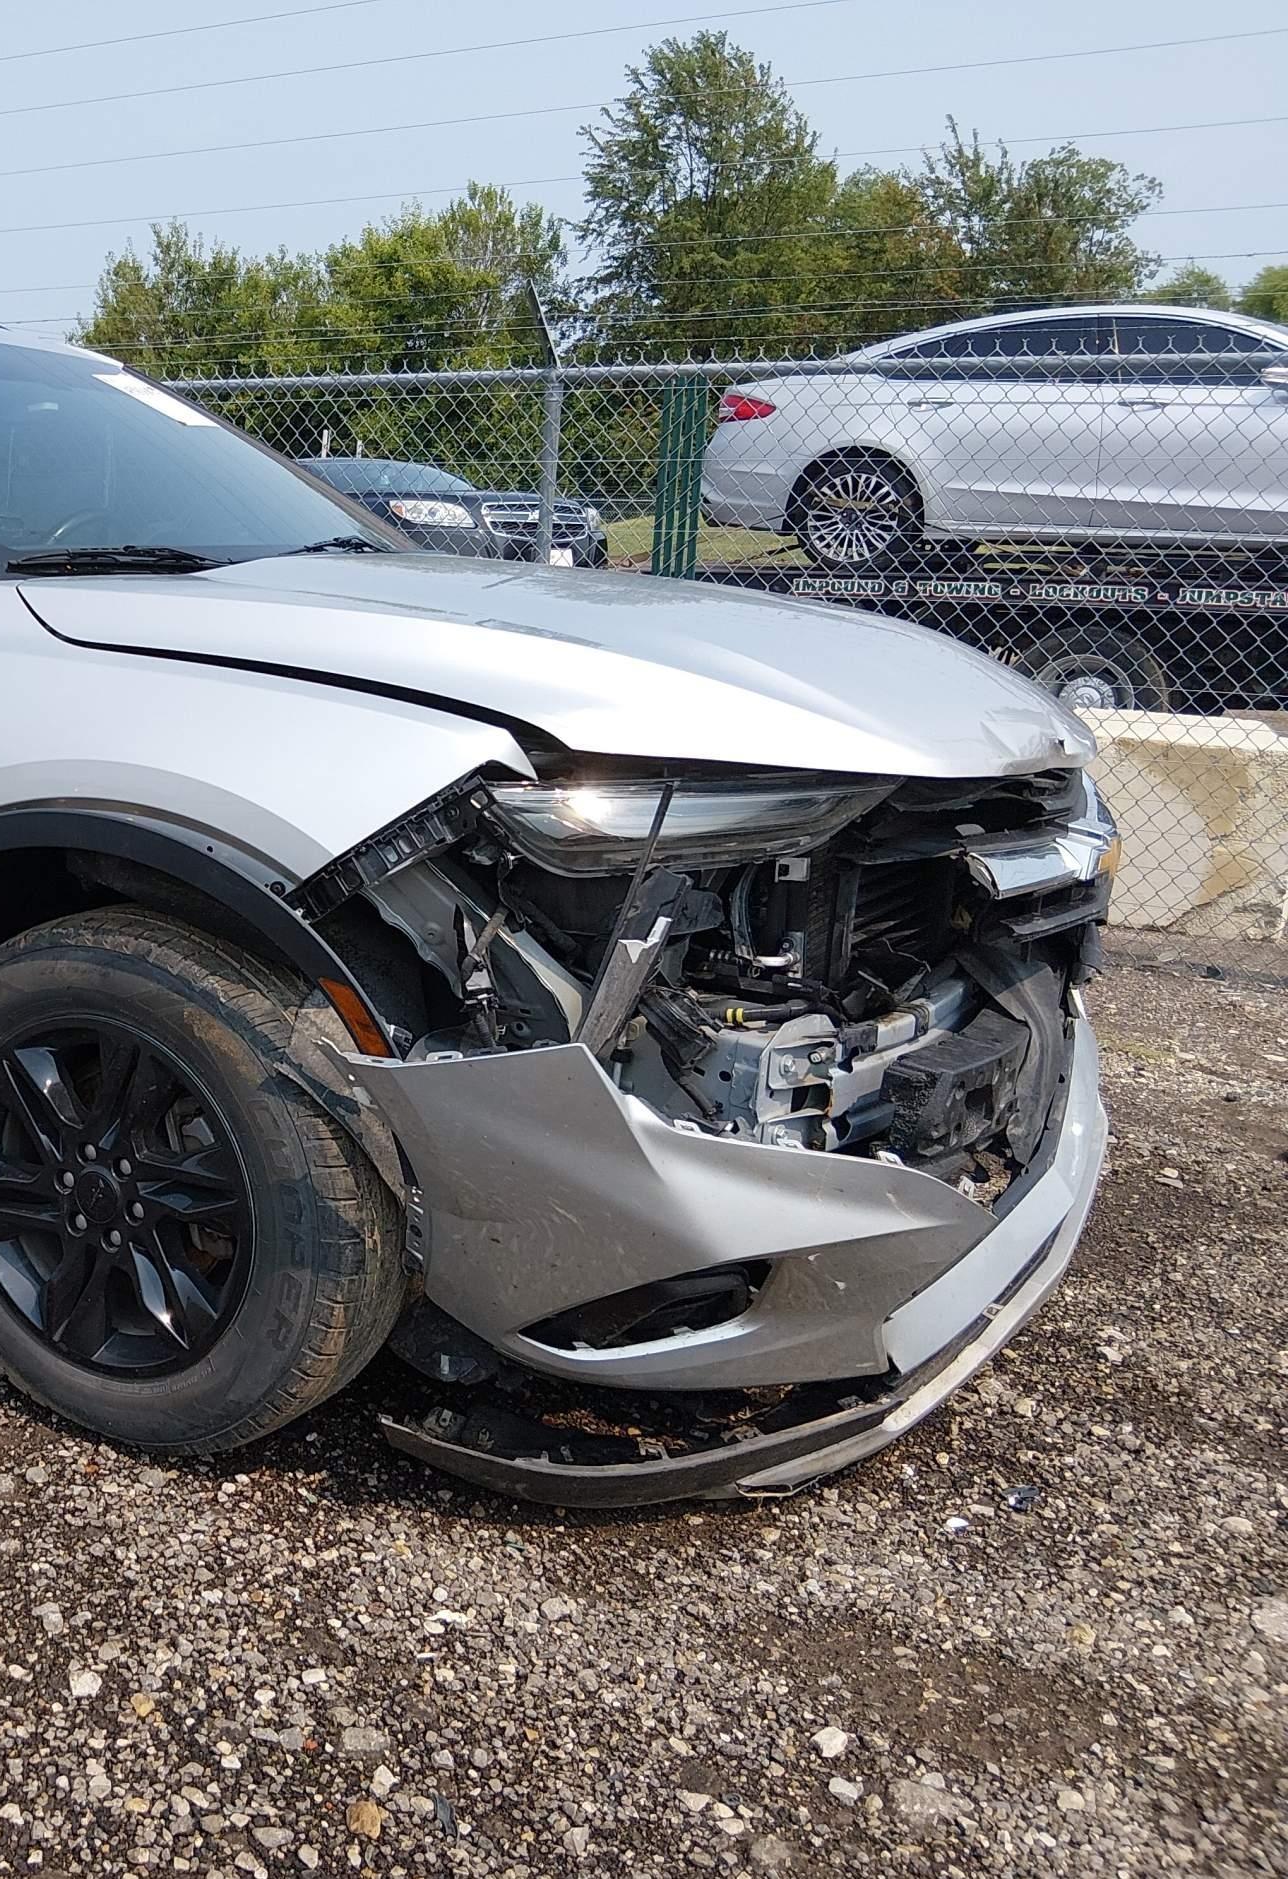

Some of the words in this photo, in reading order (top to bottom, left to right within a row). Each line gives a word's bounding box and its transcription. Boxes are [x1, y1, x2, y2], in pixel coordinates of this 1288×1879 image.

[793, 579, 884, 594] IMPOUND
[893, 581, 909, 596] &
[918, 581, 1002, 597] TOWING
[1029, 584, 1149, 601] LOCKOUTS
